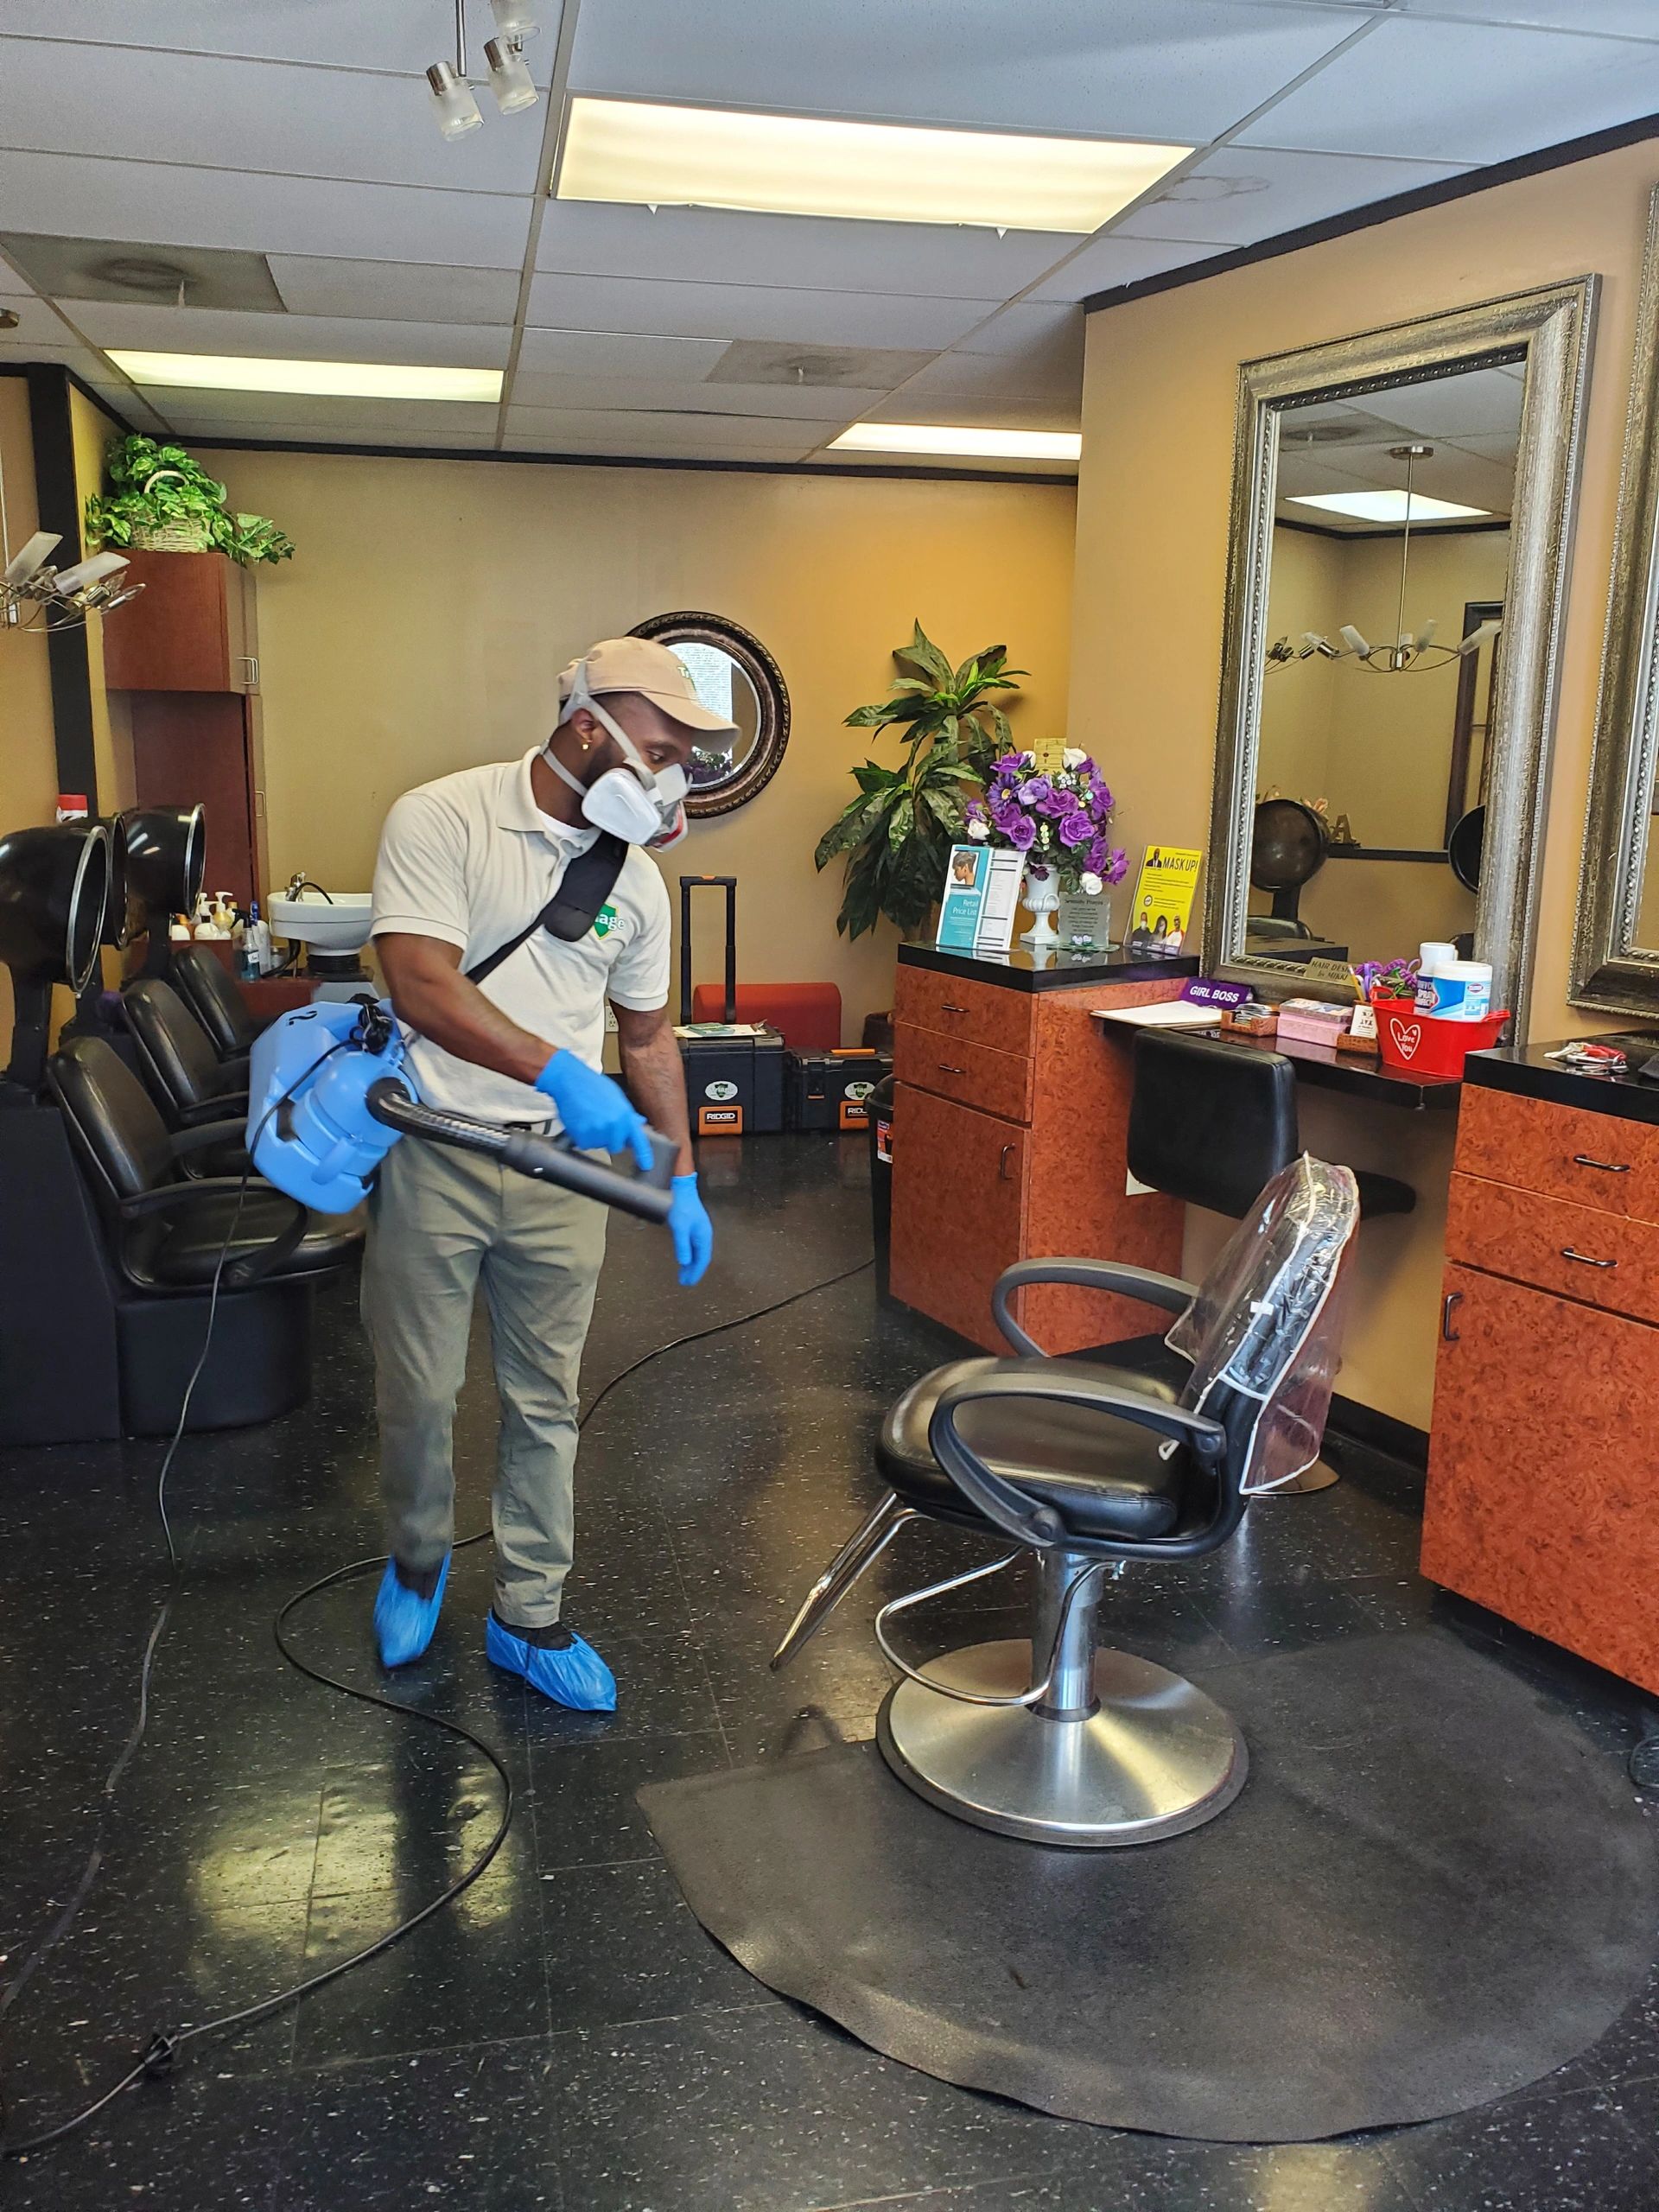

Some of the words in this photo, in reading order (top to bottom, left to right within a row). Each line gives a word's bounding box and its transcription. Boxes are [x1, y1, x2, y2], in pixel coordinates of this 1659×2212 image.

[1162, 856, 1185, 871] MASK
[1185, 859, 1198, 873] UP!
[952, 906, 966, 915] Price
[967, 907, 977, 916] List
[1311, 960, 1331, 969] HAIR
[1189, 985, 1211, 998] GIRL
[1211, 989, 1240, 1003] BOSS
[1396, 1032, 1415, 1043] Love
